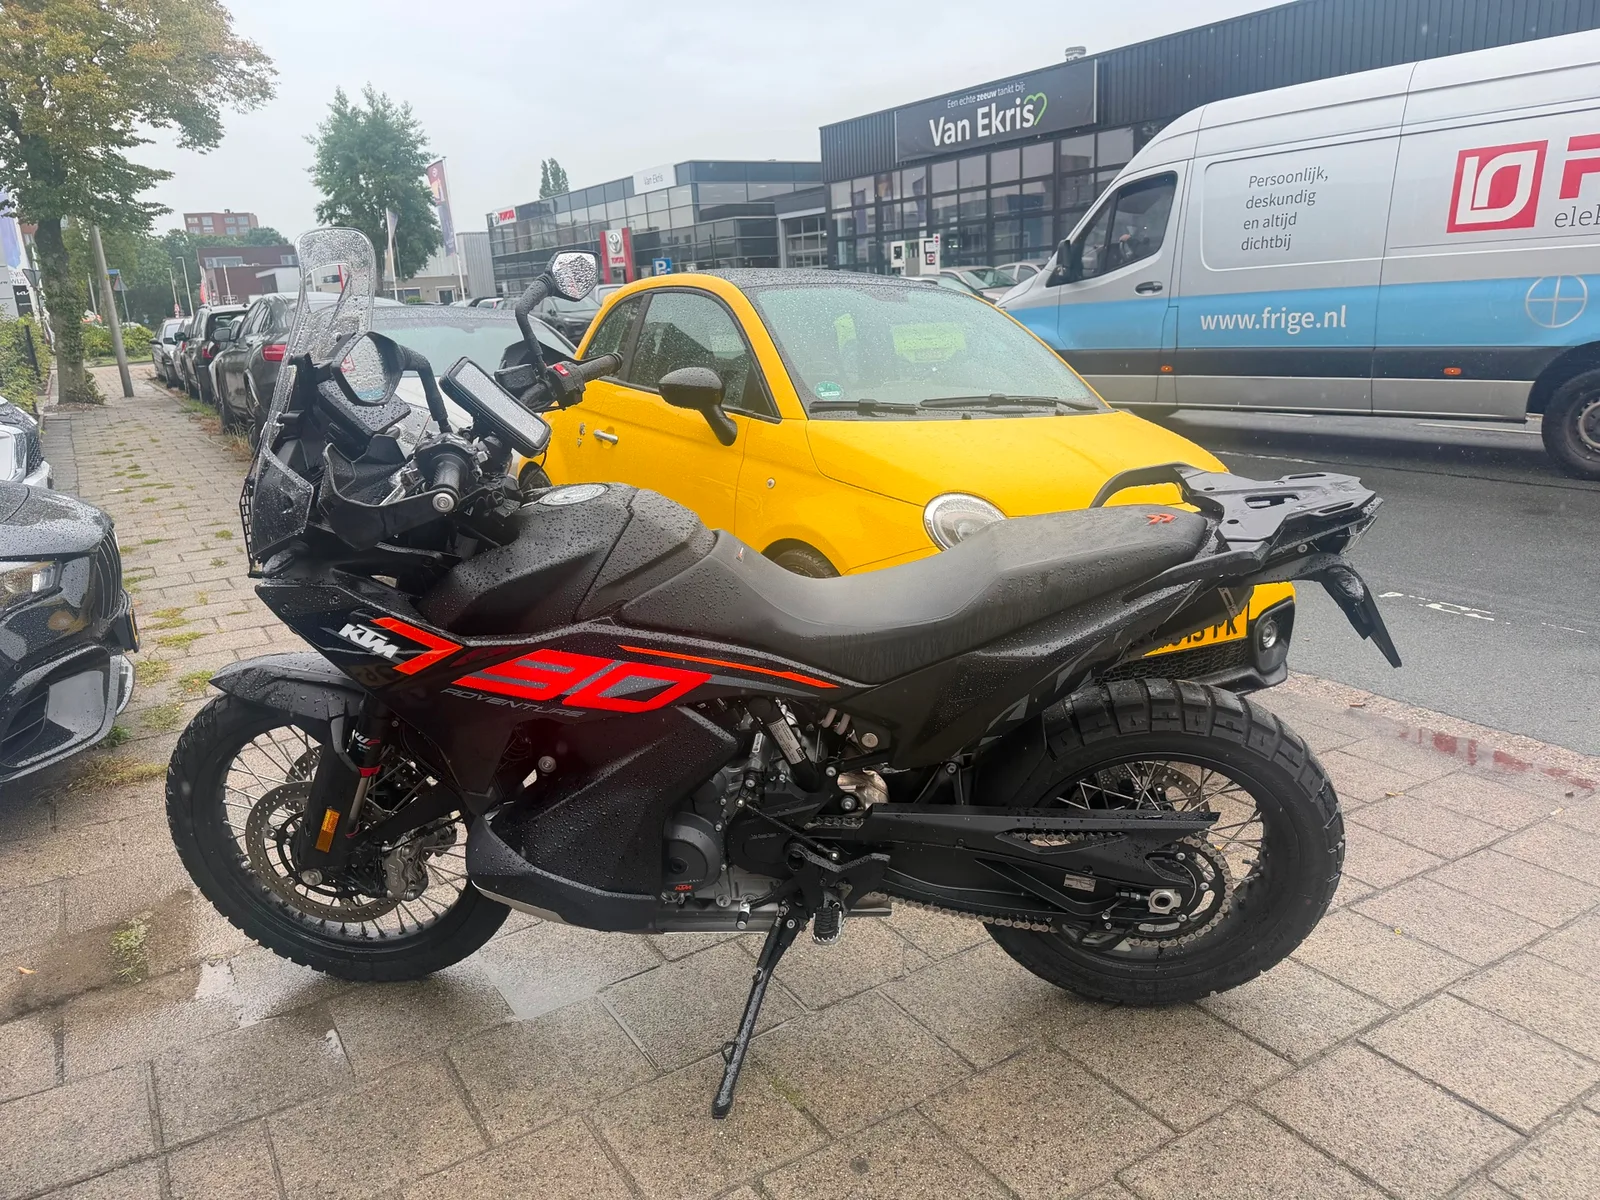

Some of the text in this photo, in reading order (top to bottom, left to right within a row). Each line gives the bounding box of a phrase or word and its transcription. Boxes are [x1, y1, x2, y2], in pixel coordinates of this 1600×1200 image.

[947, 81, 1026, 108] Een echte zeeuw tankt bij:
[929, 97, 1035, 147] Van Ekris
[1248, 165, 1329, 188] Persoonlijk,
[1245, 189, 1317, 210] deskundig
[1243, 211, 1298, 230] en altijd
[1240, 233, 1292, 252] dichtbij
[1200, 304, 1347, 335] www.frige.nl
[338, 623, 399, 659] KTM
[440, 687, 587, 718] ADVENTURE
